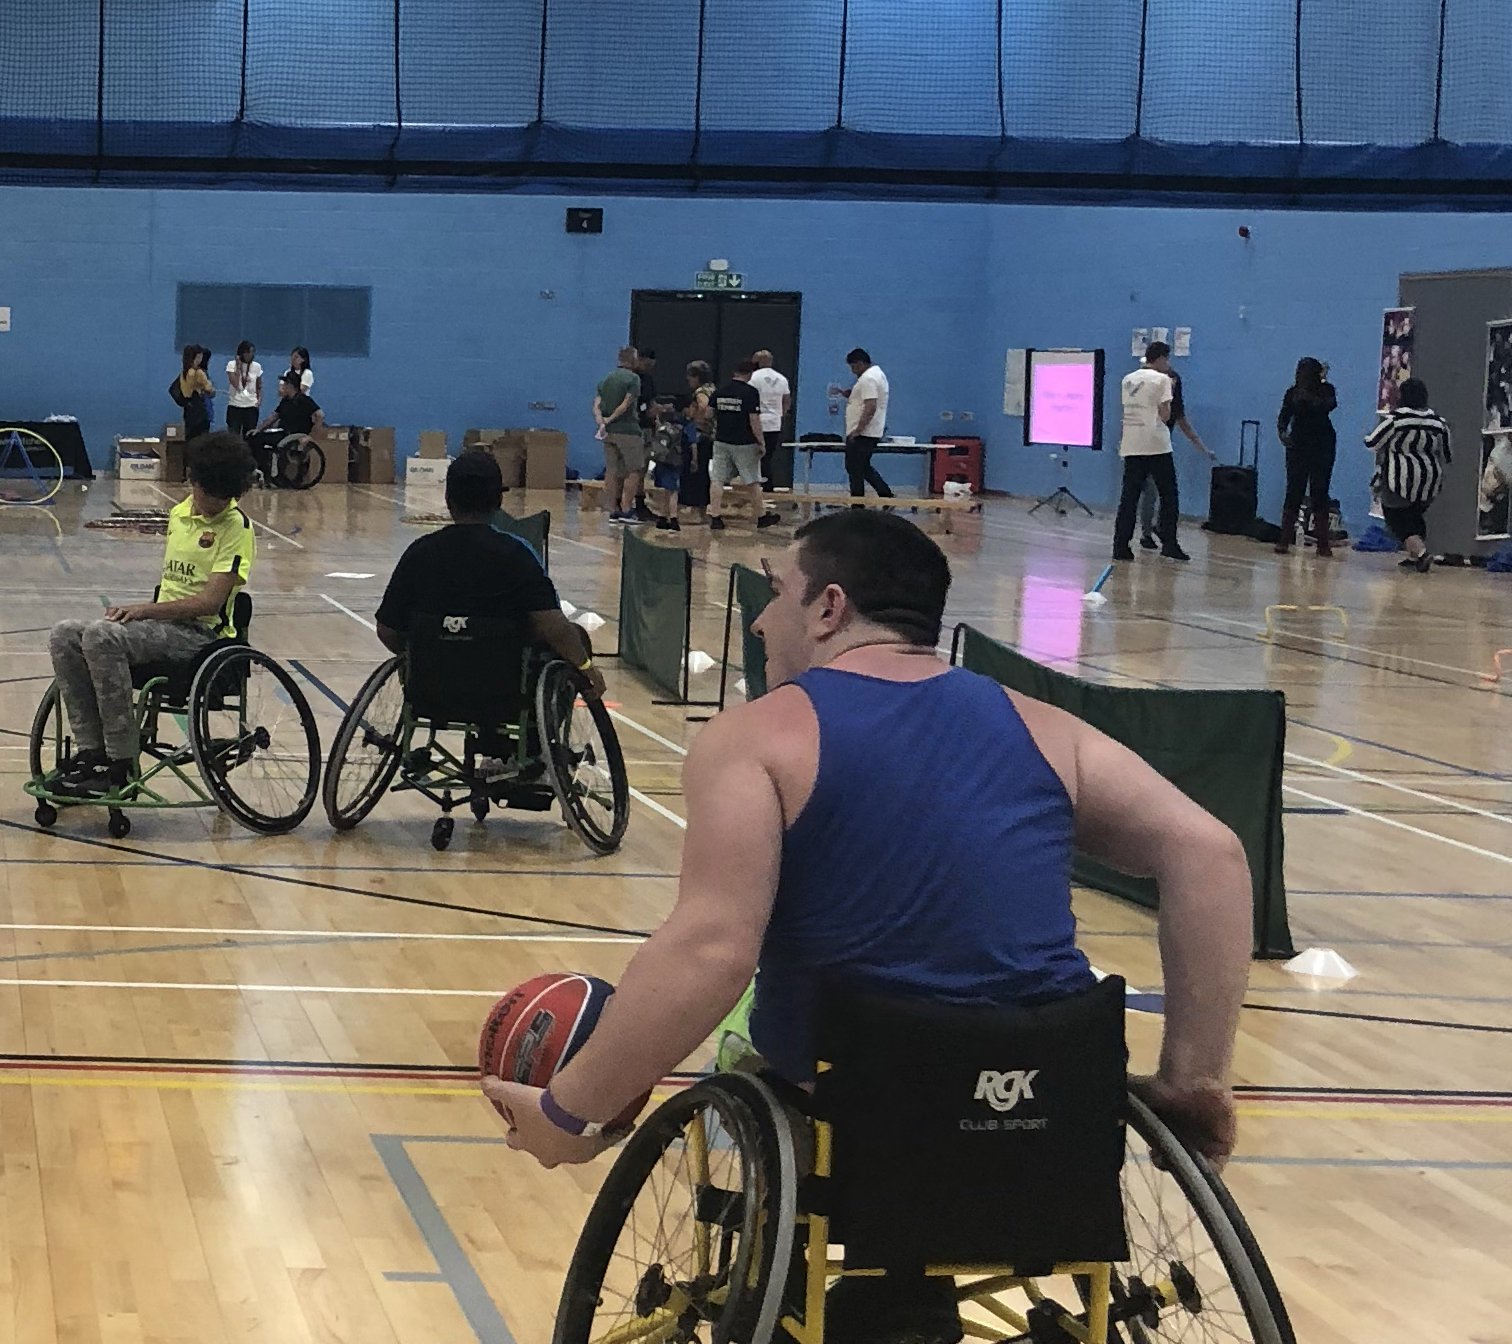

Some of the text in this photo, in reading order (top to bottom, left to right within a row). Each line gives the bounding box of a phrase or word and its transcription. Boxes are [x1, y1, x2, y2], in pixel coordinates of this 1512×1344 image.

[163, 559, 196, 577] ATAR
[973, 1069, 1040, 1112] RGK
[959, 1118, 1049, 1131] CLUB SPORT
